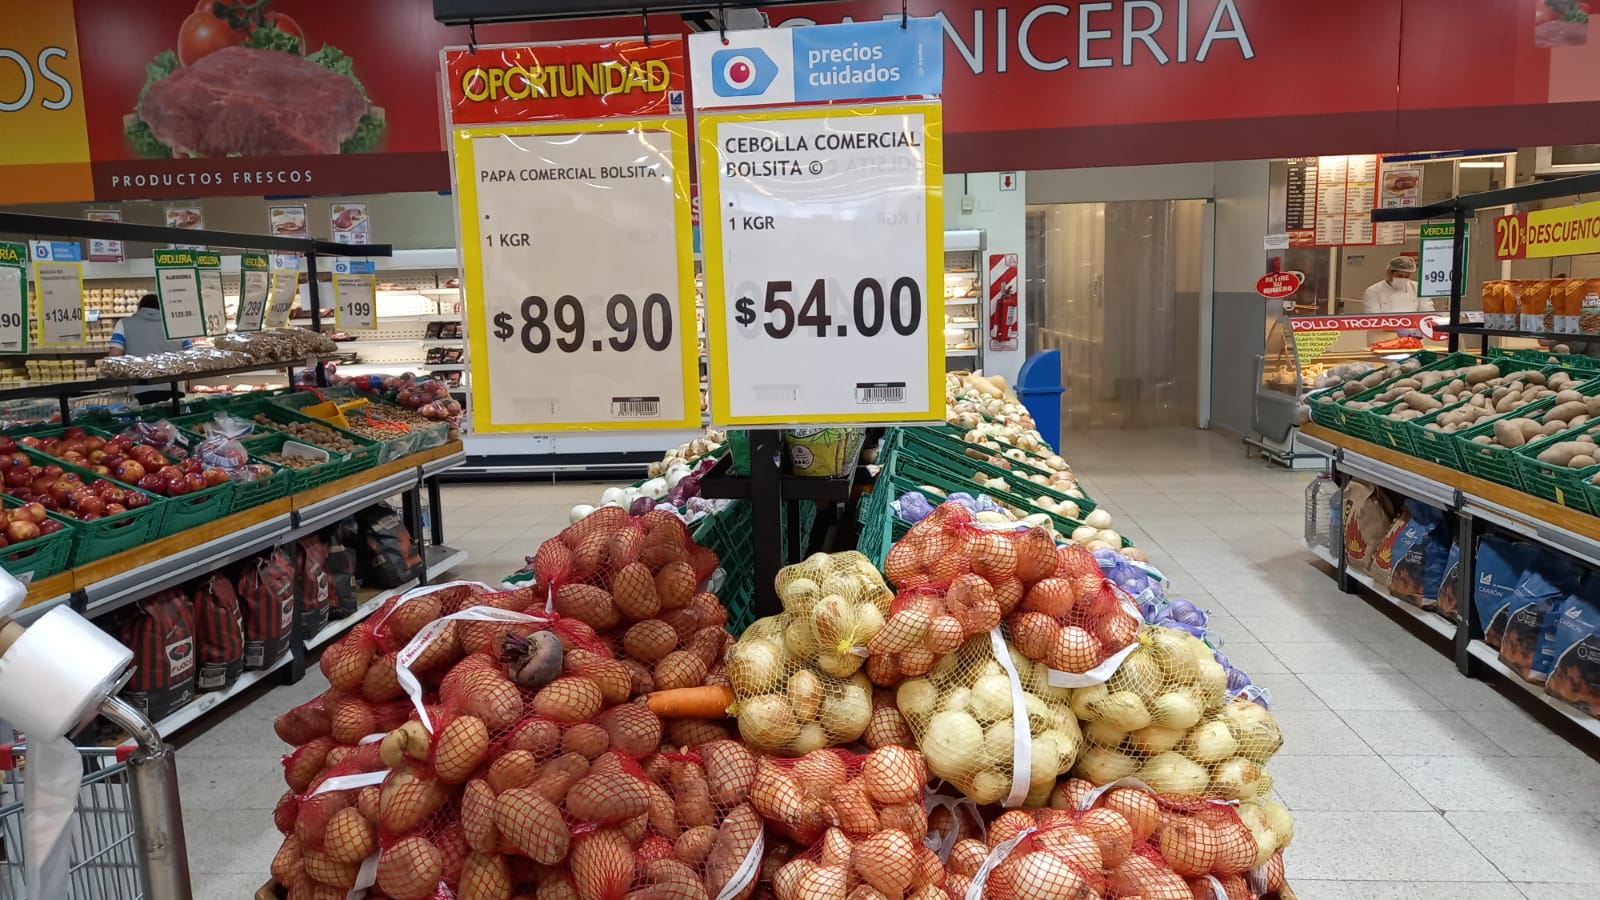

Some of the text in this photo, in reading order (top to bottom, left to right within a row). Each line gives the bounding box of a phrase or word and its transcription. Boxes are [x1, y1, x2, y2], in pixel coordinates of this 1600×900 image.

[808, 42, 882, 68] precios
[462, 59, 671, 101] OPORTUNIDAD
[808, 65, 900, 86] cuidados
[725, 130, 921, 154] CEBOLLA COMERCIAL
[112, 169, 313, 188] PRODUCTOS FRESCOS
[480, 165, 657, 182] PAPA COMERCIAL BOLSITA
[726, 160, 802, 178] BOLSITA
[729, 215, 775, 231] 1 KGR
[486, 233, 530, 247] 1 KGR
[1497, 215, 1600, 257] 20% DESCUENTO
[735, 276, 923, 340] $54.00
[493, 293, 673, 354] $89.90
[1292, 317, 1411, 330] POLLO TROZADO
